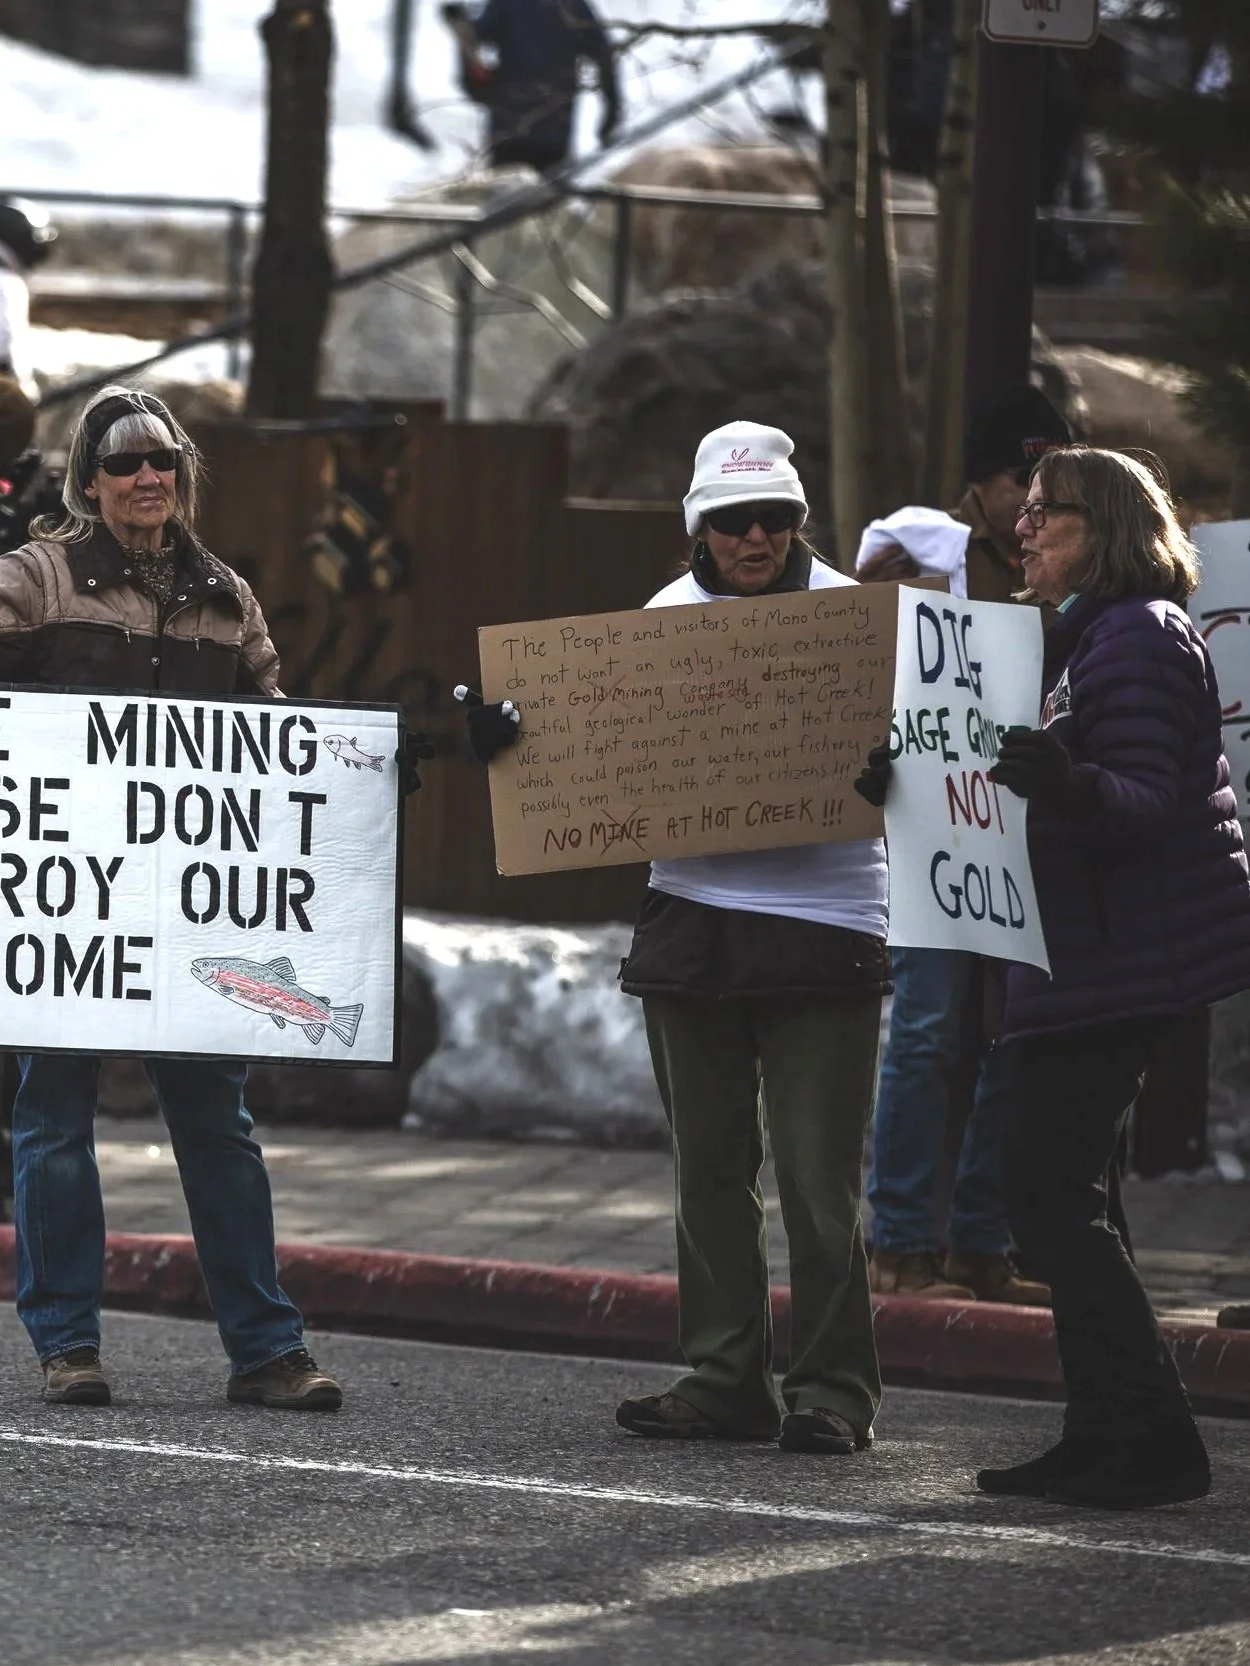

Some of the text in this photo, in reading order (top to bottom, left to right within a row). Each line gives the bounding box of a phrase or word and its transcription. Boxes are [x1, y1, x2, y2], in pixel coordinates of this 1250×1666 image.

[502, 599, 869, 660] The People and visitors of Mono County
[915, 601, 983, 699] DIG
[506, 667, 527, 690] do
[541, 663, 570, 684] not
[636, 662, 654, 673] an
[793, 631, 877, 653] extractive
[514, 691, 555, 712] rivate
[568, 687, 604, 706] Gold
[762, 661, 840, 684] destroying
[857, 655, 896, 668] our
[87, 700, 318, 776] MINING
[516, 704, 886, 766] We will fight against a mine at Hot Creek
[585, 703, 652, 736] geological
[666, 701, 726, 721] wonder
[745, 693, 763, 709] of
[776, 688, 807, 705] Hot
[889, 707, 959, 763] SAGE
[517, 771, 554, 790] which
[616, 760, 658, 782] poison
[672, 756, 697, 768] our
[764, 747, 790, 759] our
[798, 733, 862, 764] fishery
[521, 793, 571, 818] possibly
[579, 793, 609, 807] even
[620, 782, 644, 797] the
[651, 777, 699, 794] health
[706, 769, 726, 786] of
[736, 772, 761, 785] our
[946, 770, 1004, 834] NOT
[543, 826, 582, 854] NO
[590, 817, 651, 848] MINE
[666, 815, 693, 839] AT
[702, 805, 739, 833] HOT
[745, 797, 813, 827] CREEK
[180, 860, 316, 932] OUR
[930, 850, 1026, 929] GOLD
